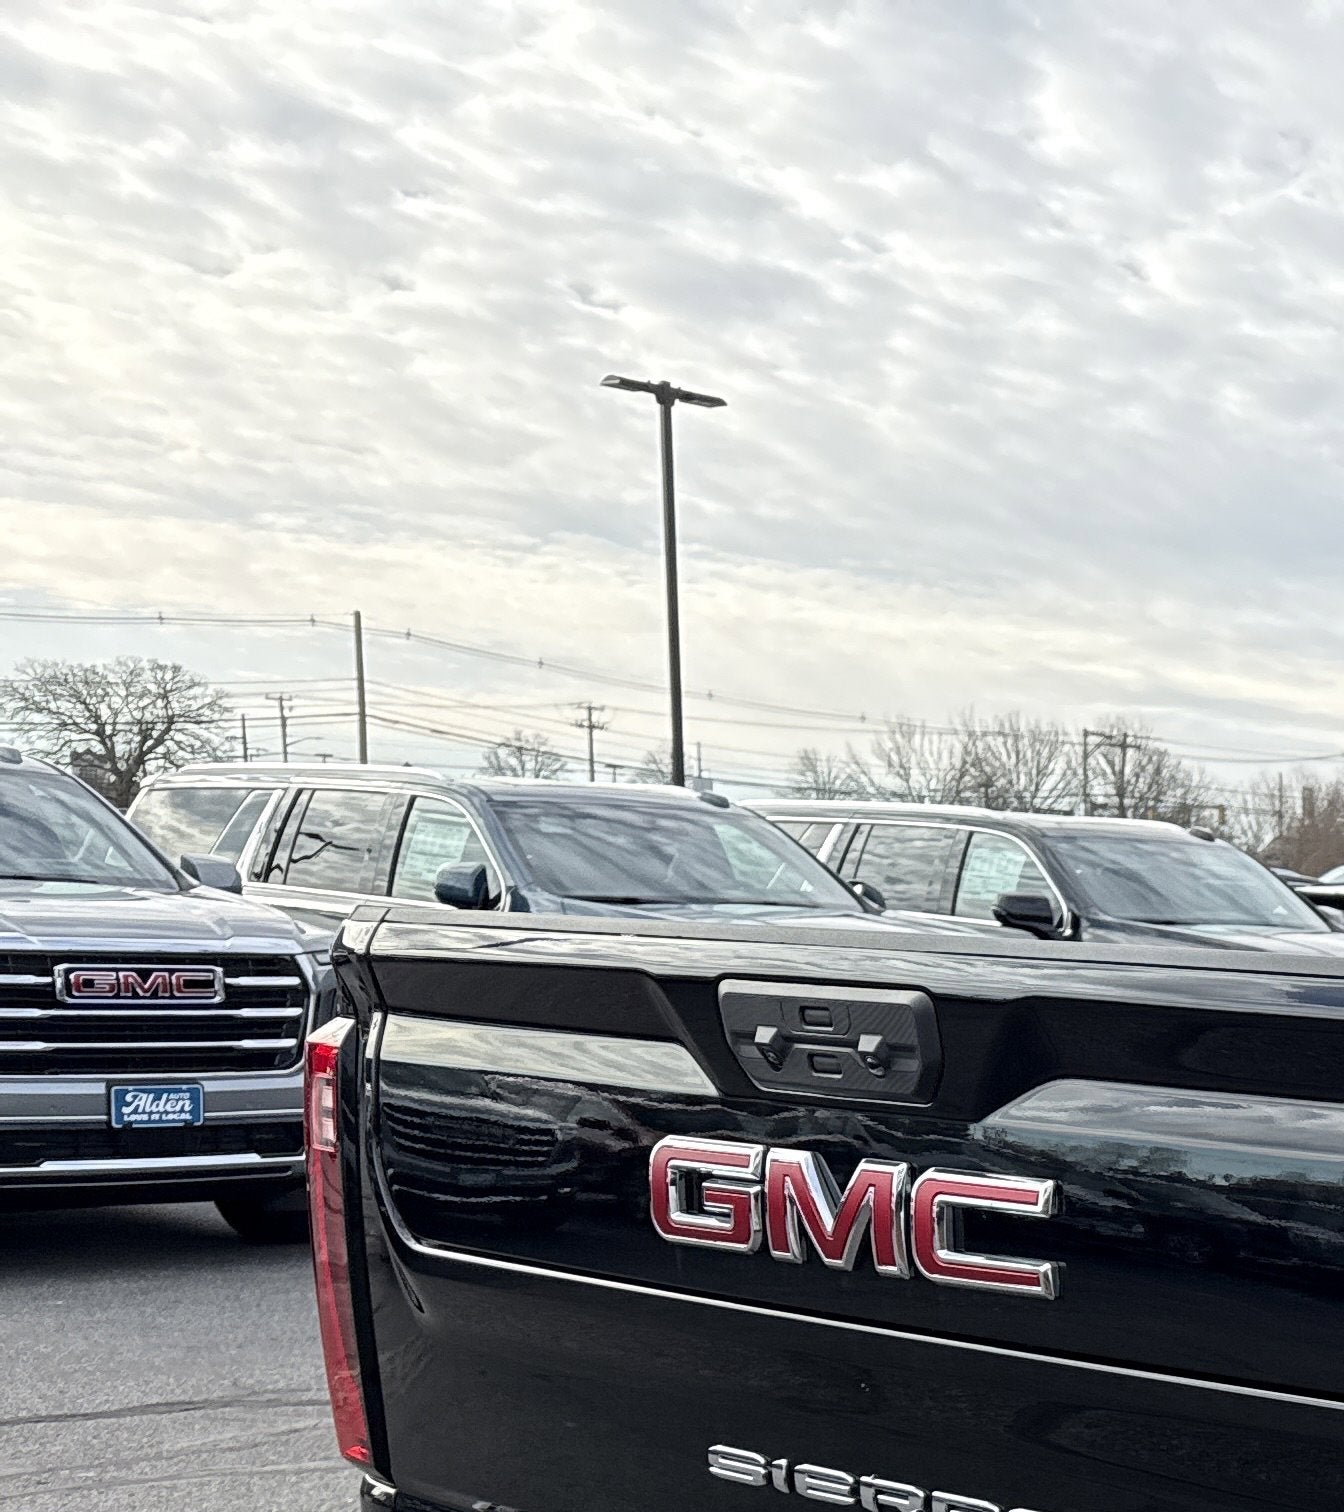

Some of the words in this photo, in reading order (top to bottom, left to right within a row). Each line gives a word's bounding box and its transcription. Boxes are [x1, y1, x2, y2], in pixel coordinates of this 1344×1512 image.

[69, 971, 215, 997] GMC
[121, 1092, 194, 1114] Alden
[649, 1134, 1062, 1300] GMC
